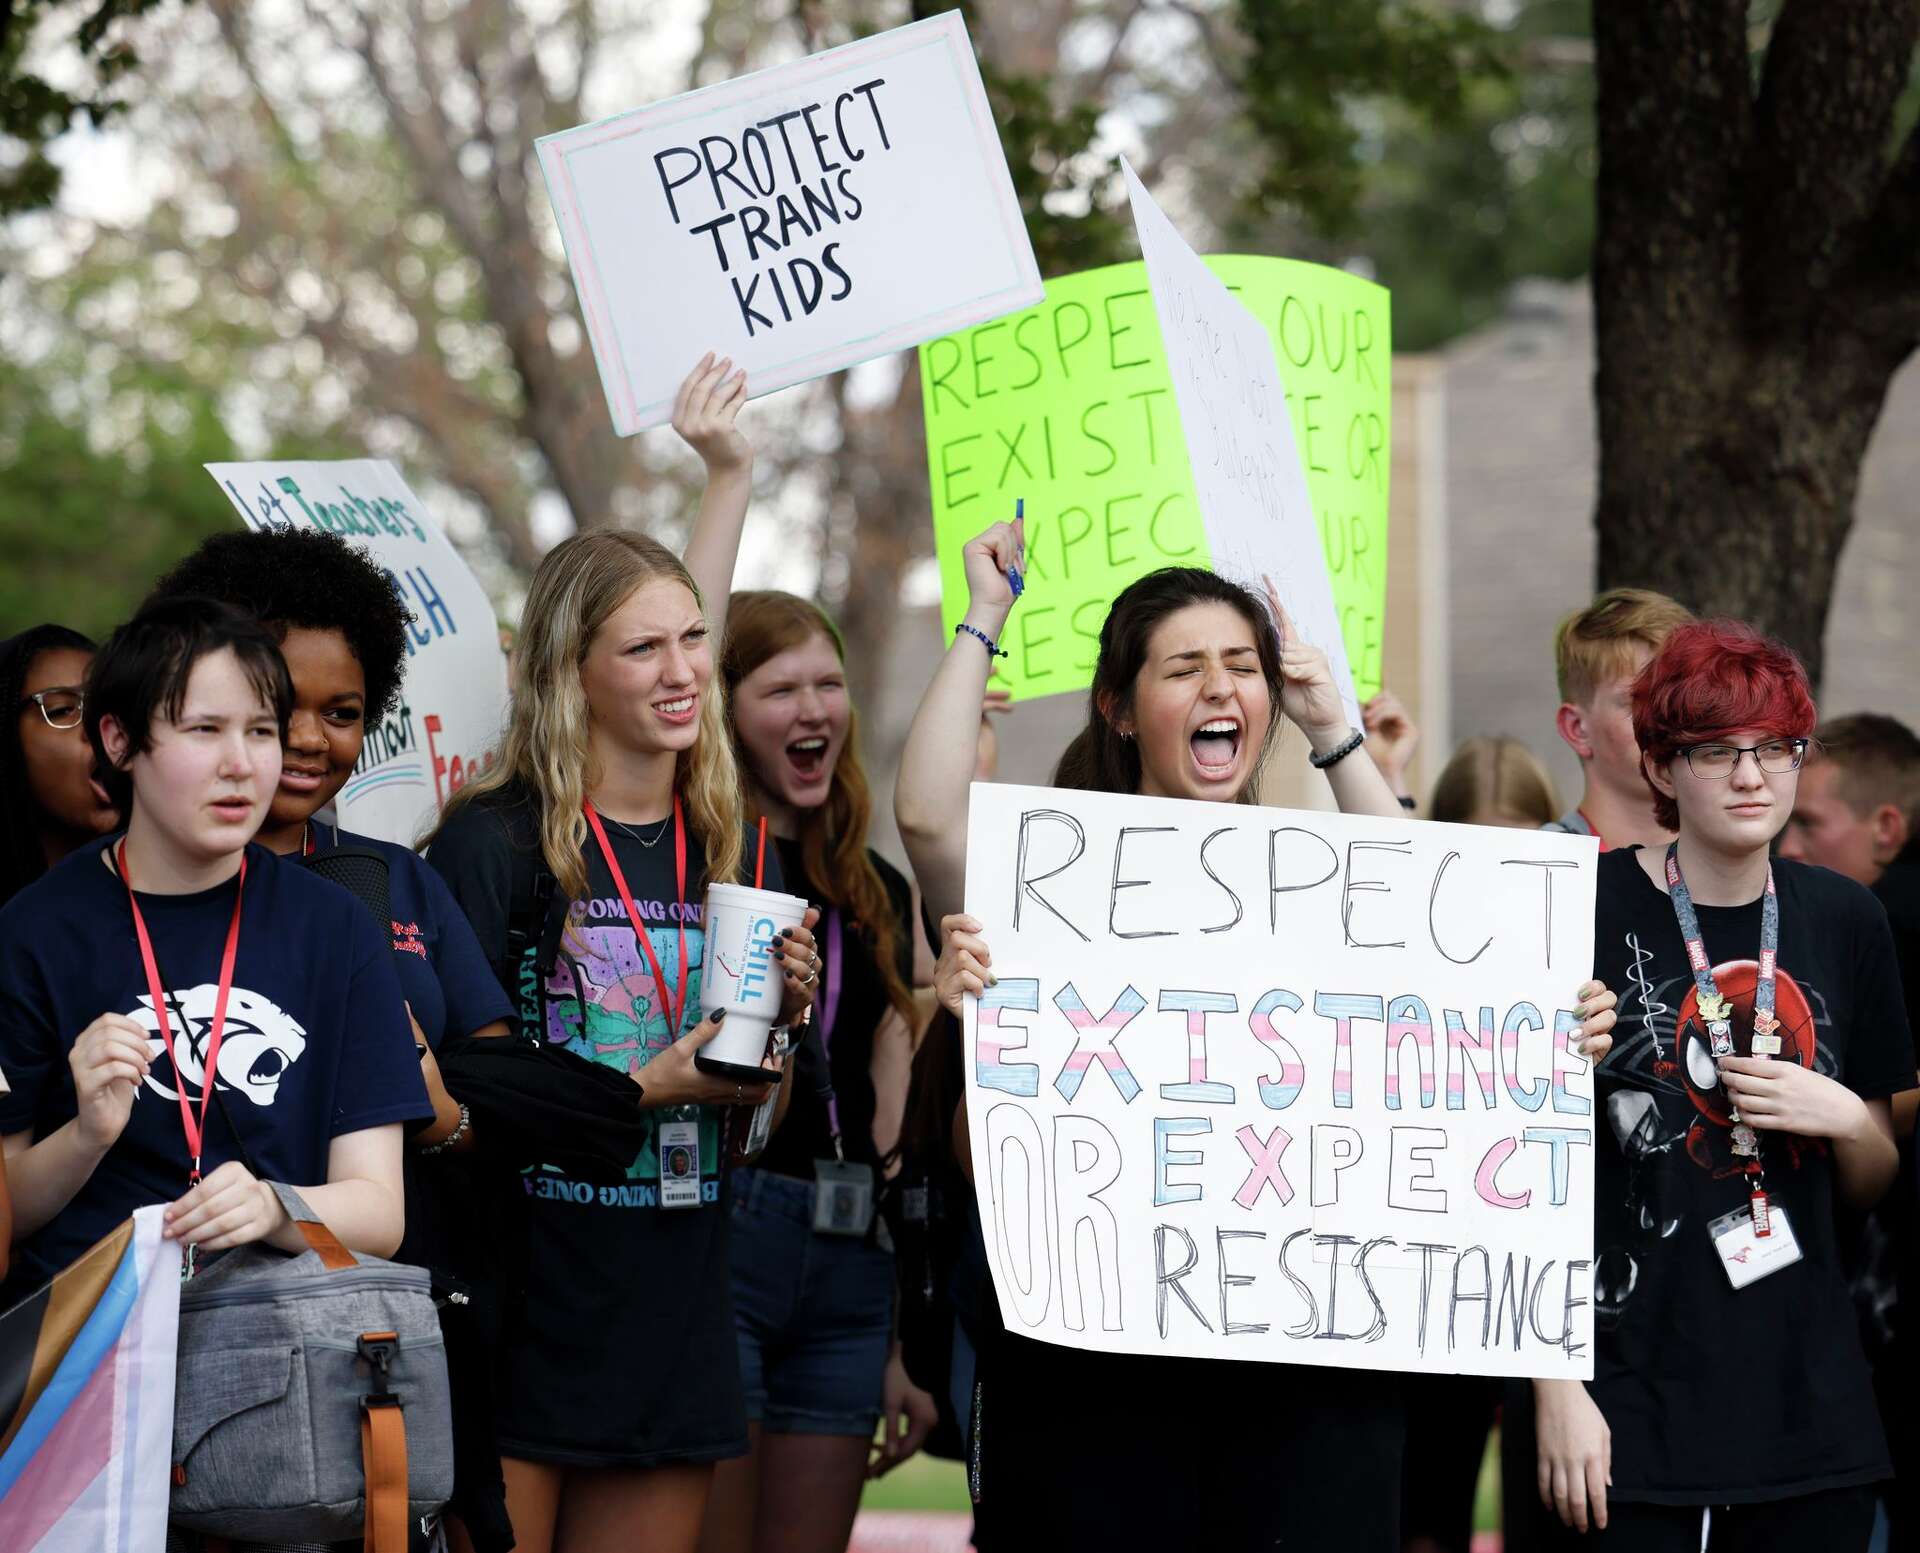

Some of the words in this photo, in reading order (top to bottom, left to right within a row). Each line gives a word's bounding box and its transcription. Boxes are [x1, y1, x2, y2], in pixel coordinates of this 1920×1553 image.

[653, 78, 891, 224] PROTECT
[689, 169, 863, 273] TRANS
[731, 242, 852, 337] KIDS
[1280, 295, 1378, 391] OUR
[1346, 413, 1385, 493] OR
[225, 480, 296, 530] Let
[276, 476, 426, 543] Teachers
[1012, 808, 1579, 969] RESPECT
[739, 917, 776, 1003] CHILL
[975, 977, 1591, 1115] EXISTANCE
[985, 1102, 1124, 1331] OR
[1152, 1116, 1591, 1213] EXPECT
[1752, 1197, 1769, 1234] MARVEL
[1152, 1223, 1592, 1358] RESISTANCE
